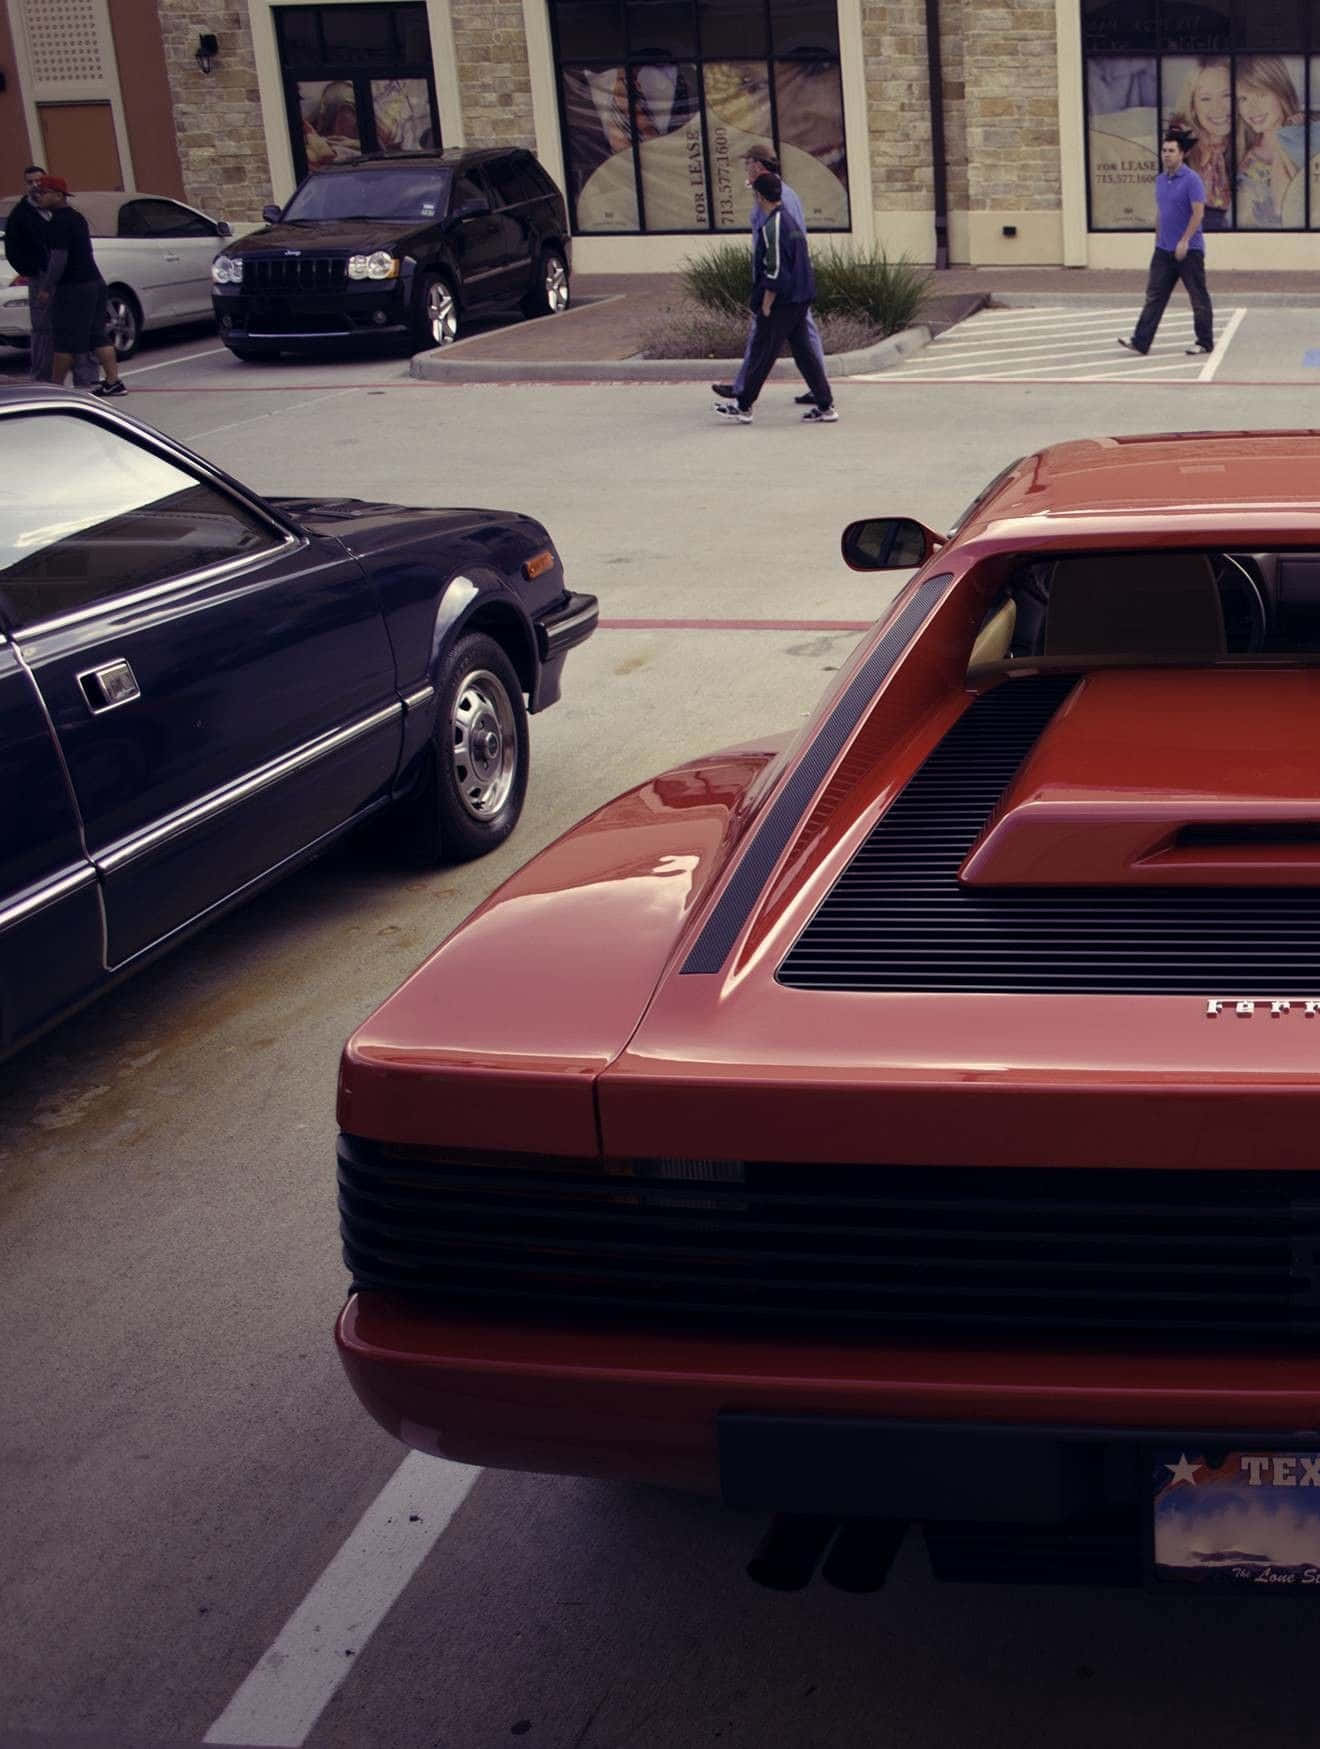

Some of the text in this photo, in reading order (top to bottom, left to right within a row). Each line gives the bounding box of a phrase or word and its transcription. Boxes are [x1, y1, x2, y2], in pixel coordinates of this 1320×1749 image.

[1121, 160, 1156, 171] LEASE
[687, 128, 707, 224] FOR LEASE
[1232, 1567, 1250, 1579] The
[1254, 1567, 1296, 1584] Lone
